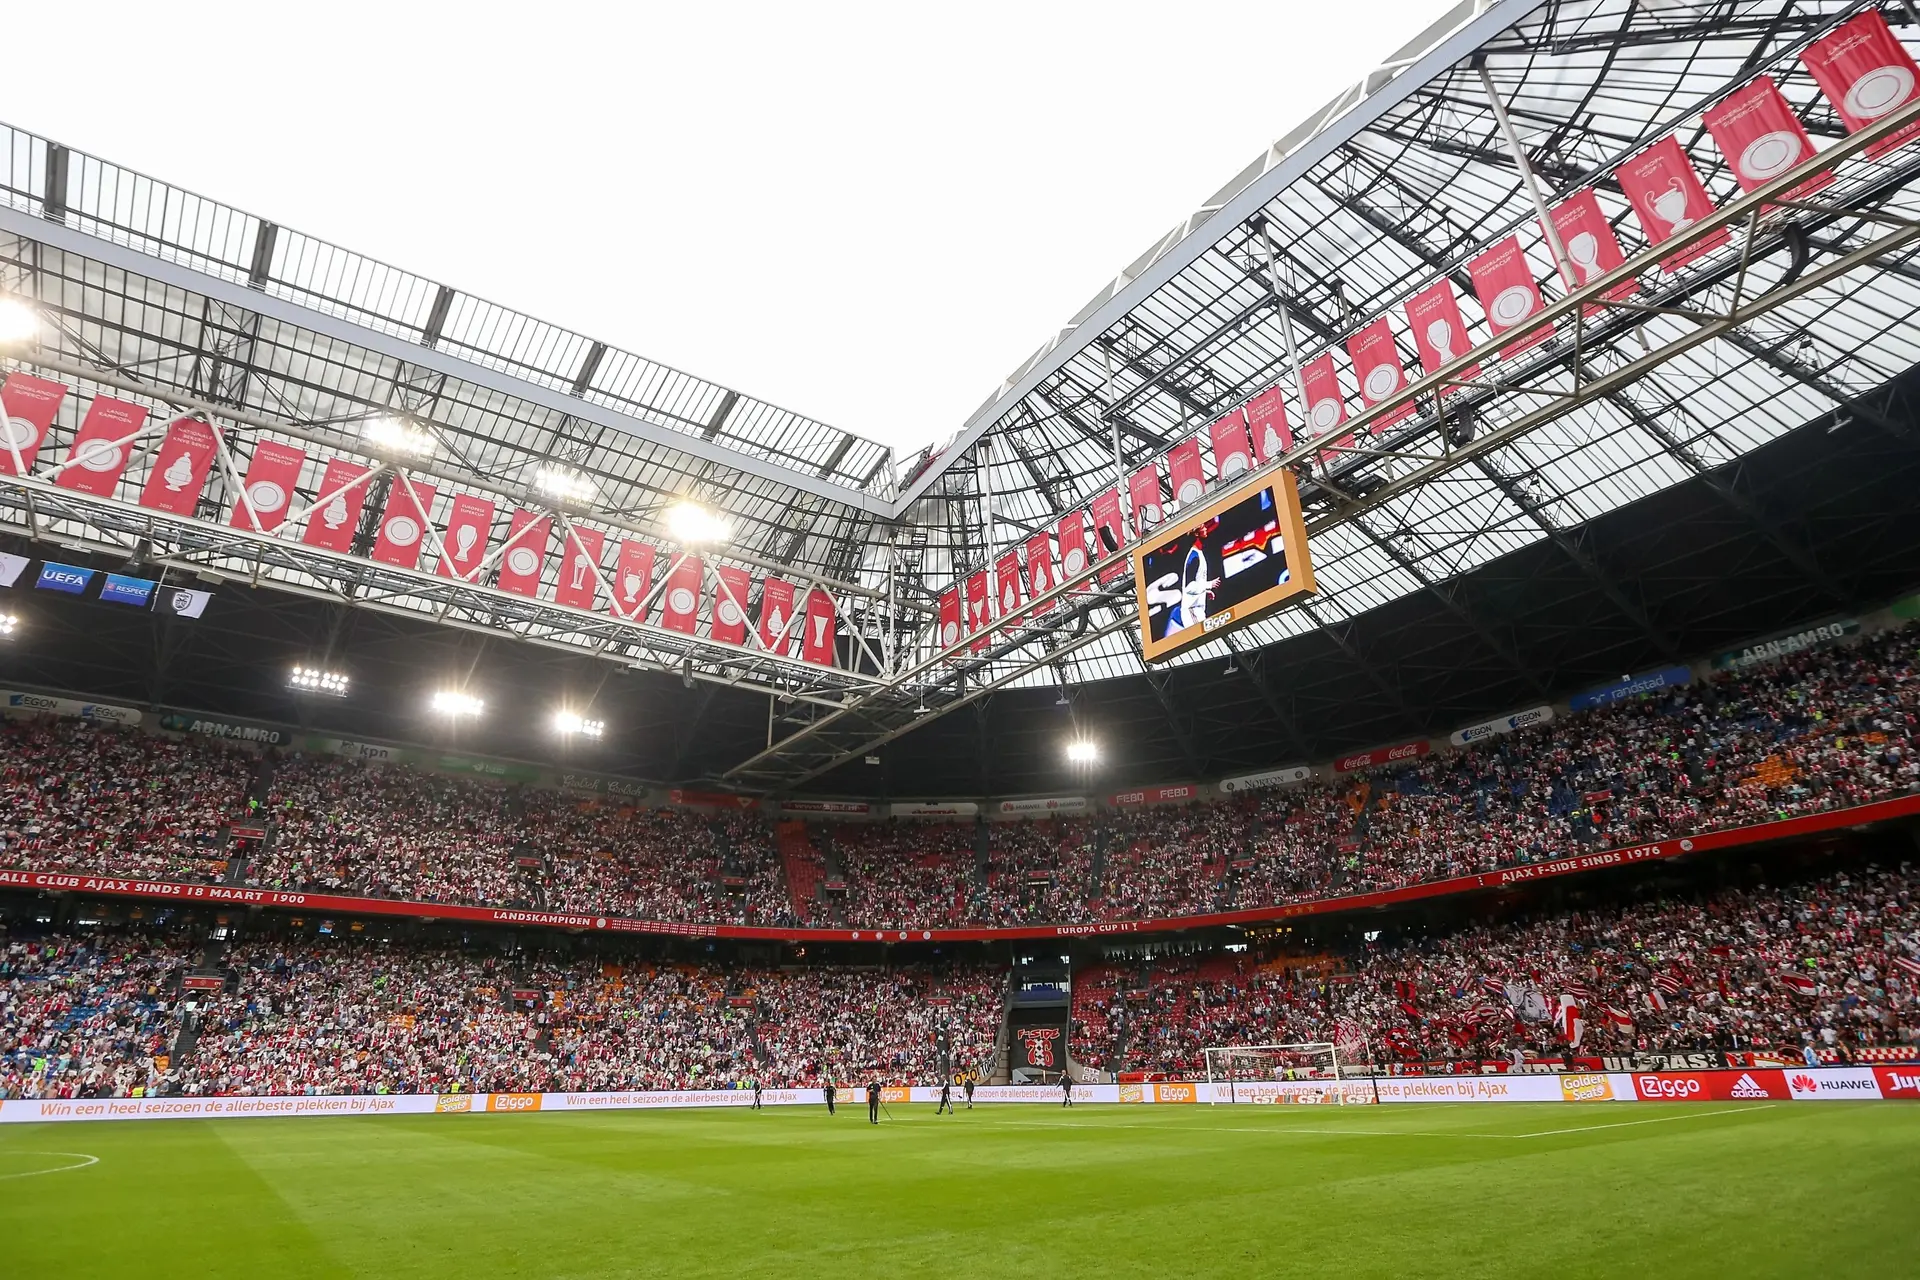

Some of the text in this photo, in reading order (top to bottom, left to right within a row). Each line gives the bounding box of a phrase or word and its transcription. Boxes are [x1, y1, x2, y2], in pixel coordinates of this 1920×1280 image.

[1712, 88, 1771, 127] NEDERLANDSE
[1634, 155, 1664, 176] EUROPA
[1555, 204, 1584, 226] UROPESE
[1556, 210, 1587, 230] UPERCUP
[1474, 246, 1516, 276] NEDERLANDSE
[1481, 256, 1512, 277] SUPERCUP
[1415, 293, 1442, 312] EUROPESE
[1416, 298, 1444, 318] SUPERCUP
[1357, 336, 1383, 354] KAMPIOEN
[1360, 334, 1377, 347] LANDS
[1306, 368, 1322, 380] LANDS
[14, 388, 50, 402] SUPERCUP
[98, 411, 133, 424] KAMPIOEN
[106, 408, 130, 418] LANDS
[178, 427, 213, 440] NATIONALE
[1220, 424, 1234, 433] LANDS
[258, 448, 300, 464] NEDERLANDSE
[262, 455, 293, 467] SUPERCUP
[460, 508, 485, 517] SUPERCUP
[462, 504, 485, 512] EUROPESE
[43, 570, 84, 586] UEFA
[116, 585, 149, 596] RESPECT
[1204, 612, 1232, 632] Ziggo
[1611, 674, 1665, 700] randstad
[359, 744, 389, 760] kpn
[563, 774, 600, 790] Grolsch
[1244, 775, 1284, 789] NORTON
[1116, 787, 1188, 804] FEBO FEBO
[1502, 846, 1661, 882] AJAX F-SIDE SINDS 1976
[36, 875, 80, 887] CLUB
[84, 879, 130, 892] AJAX
[134, 883, 181, 895] SINDS
[187, 886, 204, 896] 18
[209, 888, 264, 901] MAART
[272, 893, 305, 904] 1900
[493, 911, 591, 926] LANDSKAMPIOEN
[1057, 926, 1096, 935] EUROPA
[1017, 1028, 1061, 1040] F-SIDE
[1120, 1084, 1141, 1095] Golden
[1238, 1088, 1256, 1097] een
[1258, 1086, 1279, 1096] heel
[1282, 1085, 1321, 1096] seizoen
[1326, 1084, 1338, 1095] de
[1342, 1082, 1400, 1096] allerbeste
[1404, 1080, 1454, 1098] plekken
[1457, 1080, 1474, 1097] bij
[1477, 1080, 1508, 1098] Ajax
[1563, 1074, 1606, 1090] Golden
[1639, 1075, 1700, 1098] Ziggo
[1820, 1080, 1876, 1091] HUAWEI
[439, 1094, 470, 1105] Golden
[567, 1092, 797, 1105] Win een heel seizoen de allerbeste plekkn bij Ajax
[976, 1089, 999, 1098] seizoen
[1000, 1089, 1008, 1097] de
[1009, 1088, 1038, 1098] allerbeste
[1078, 1088, 1093, 1099] Ajax
[1160, 1085, 1189, 1099] Ziggo
[1573, 1086, 1602, 1100] Seats
[1731, 1086, 1769, 1098] adidas
[40, 1098, 394, 1116] Win een heel seizoen de allerbeste plekken bij Ajax
[495, 1095, 533, 1110] Ziggo
